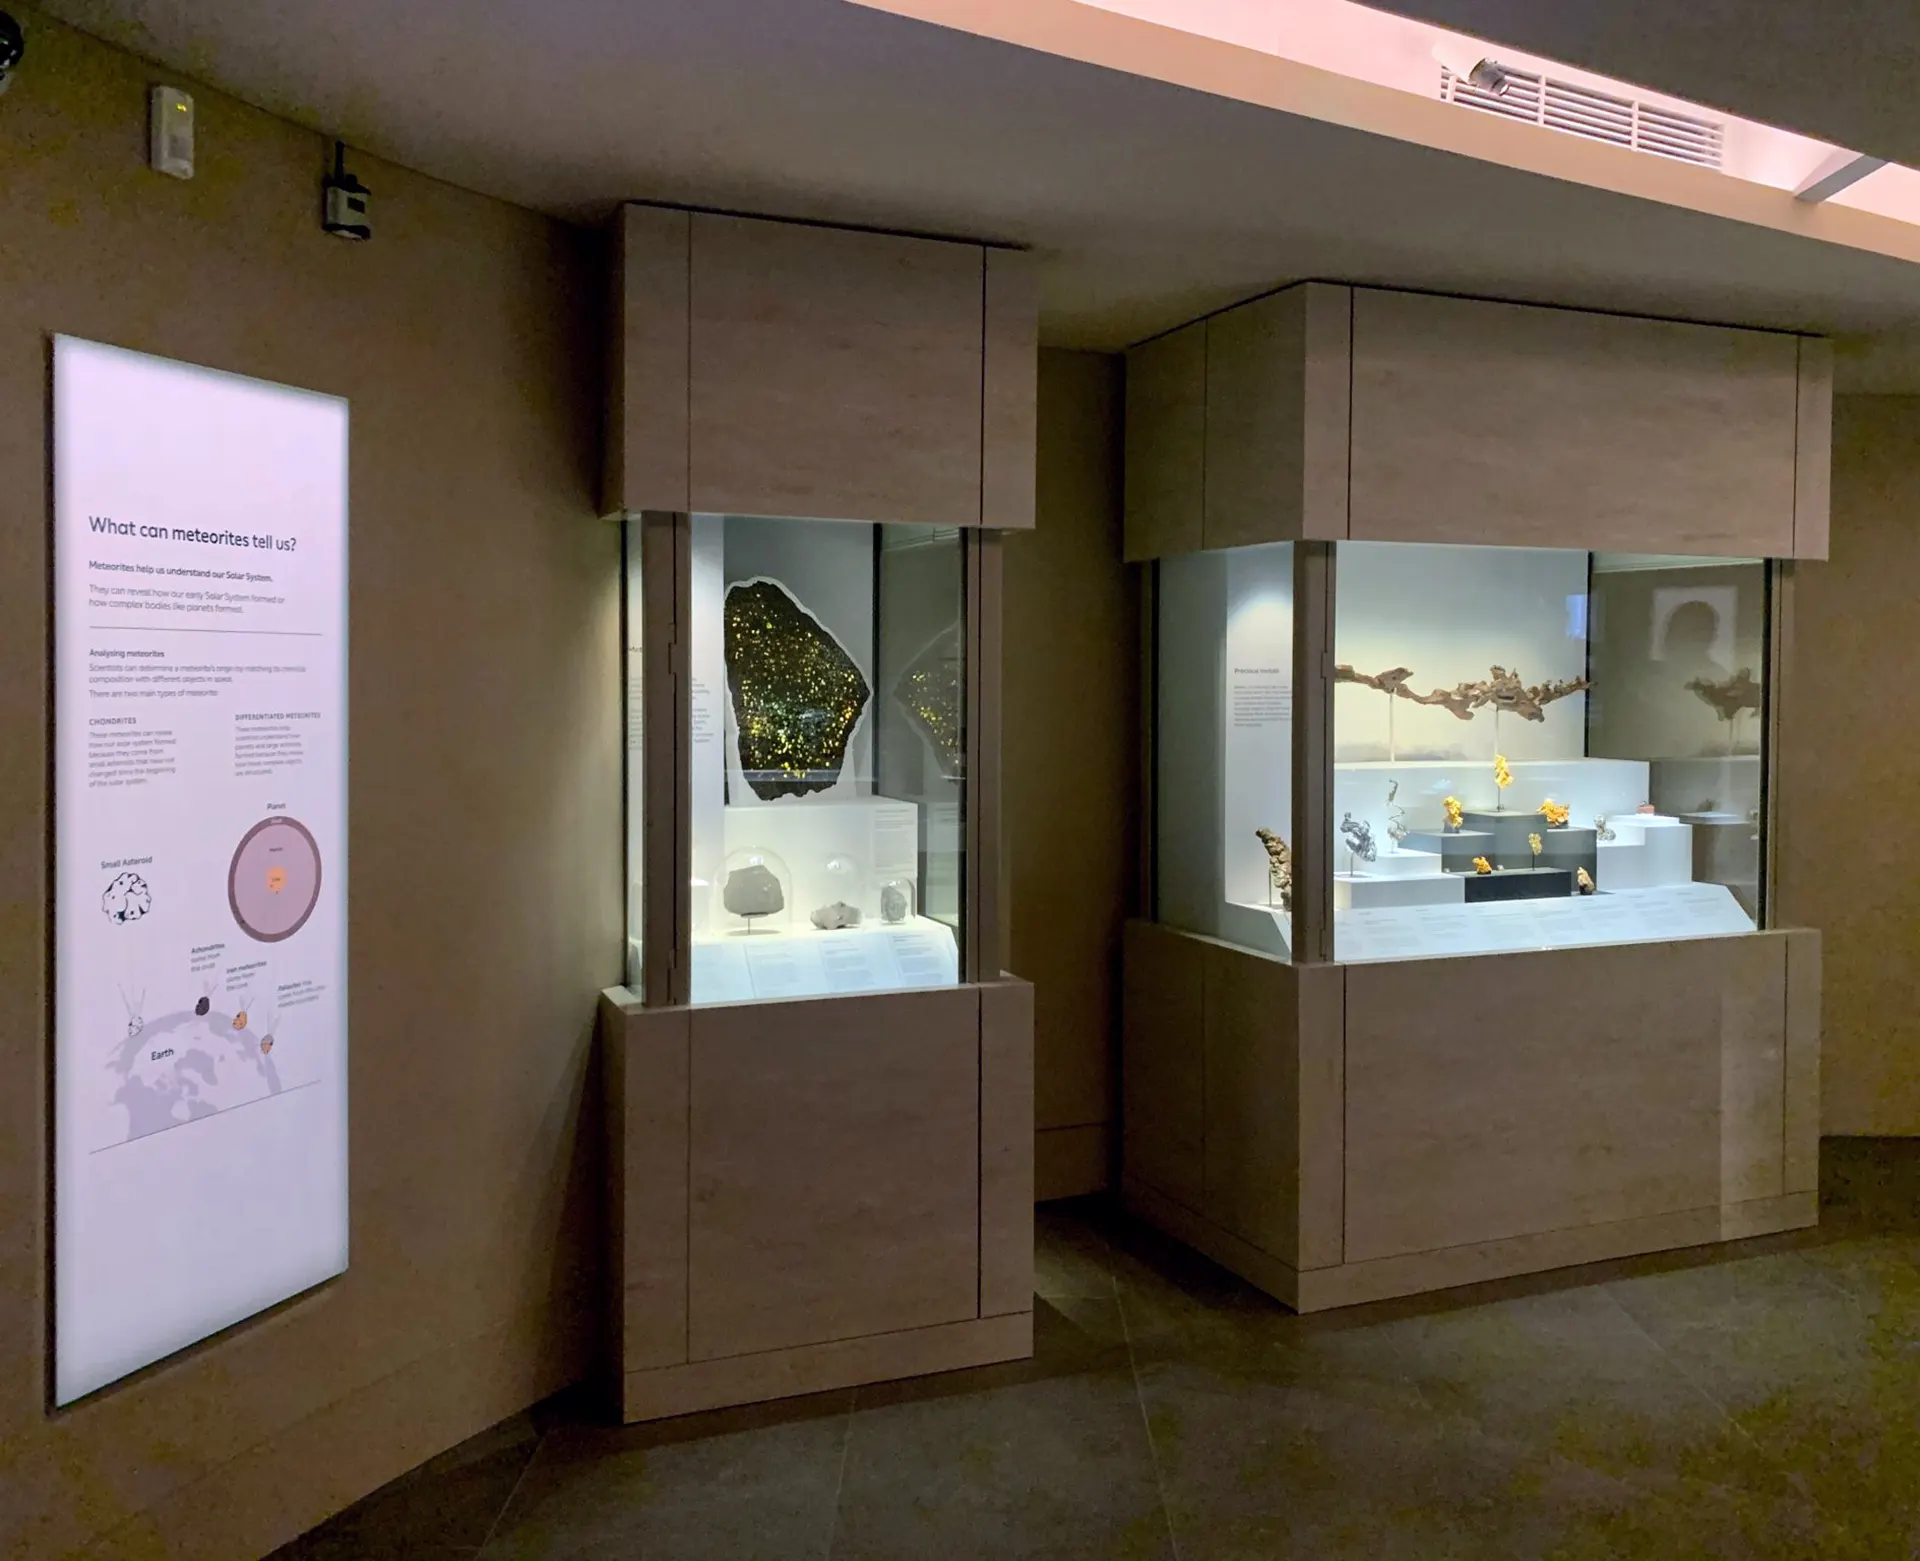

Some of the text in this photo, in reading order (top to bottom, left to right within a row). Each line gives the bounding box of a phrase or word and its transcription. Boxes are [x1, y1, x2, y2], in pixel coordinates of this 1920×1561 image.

[88, 515, 297, 552] What can meteorites tell us?
[88, 560, 134, 573] Meteorites
[136, 563, 154, 574] help
[156, 566, 165, 575] us
[166, 566, 211, 578] understand
[212, 571, 225, 579] our
[226, 570, 245, 580] Solar
[89, 583, 109, 596] They
[111, 587, 126, 596] can
[152, 589, 170, 598] how
[171, 591, 184, 599] our
[185, 591, 203, 601] early
[204, 590, 224, 601] Solar
[88, 598, 107, 608] how
[109, 600, 143, 610] complex
[145, 601, 171, 611] bodies
[172, 602, 186, 611] like
[187, 603, 214, 613] planets
[89, 648, 165, 659] Analysing meteorites
[88, 716, 137, 726] CHONDRITES
[235, 712, 285, 721] DIFFERENTIATED
[100, 856, 153, 870] Small Asteroid
[151, 1048, 174, 1061] Earth
